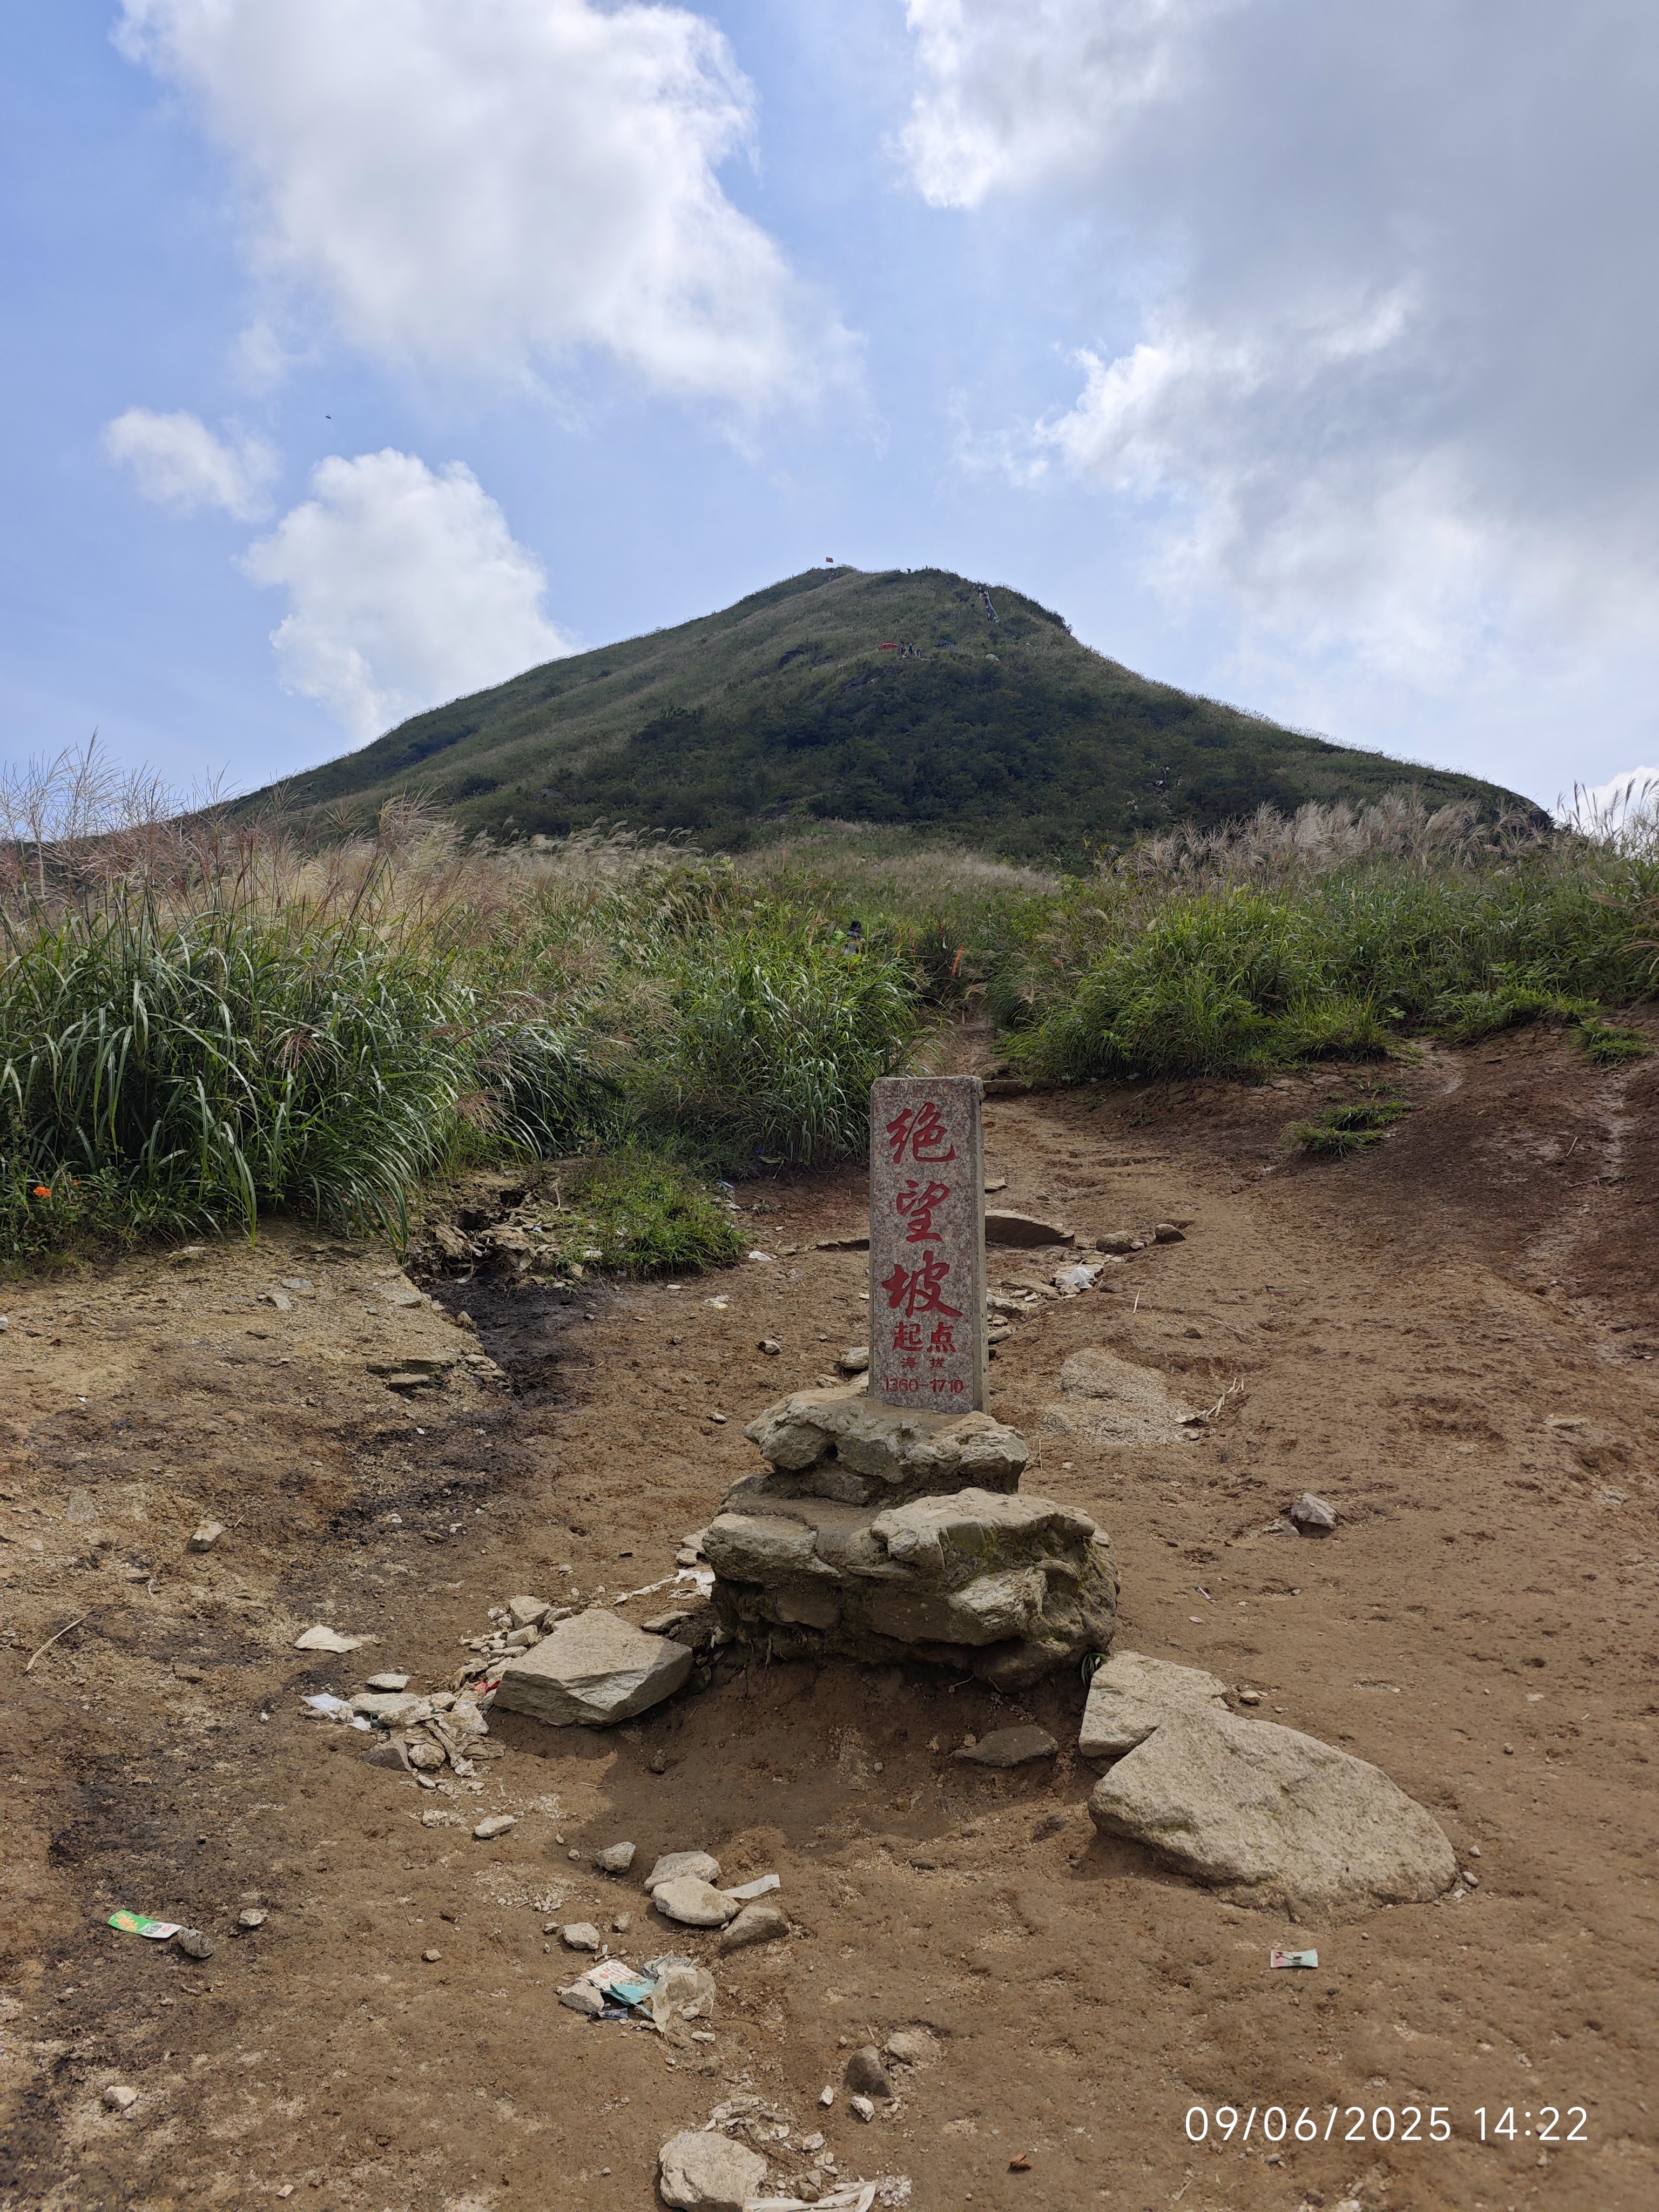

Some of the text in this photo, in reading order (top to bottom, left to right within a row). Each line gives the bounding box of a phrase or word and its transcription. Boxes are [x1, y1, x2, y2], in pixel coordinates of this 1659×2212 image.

[882, 1102, 963, 1318] 绝望坡
[893, 1321, 957, 1353] 起点
[900, 1357, 946, 1369] 海拔
